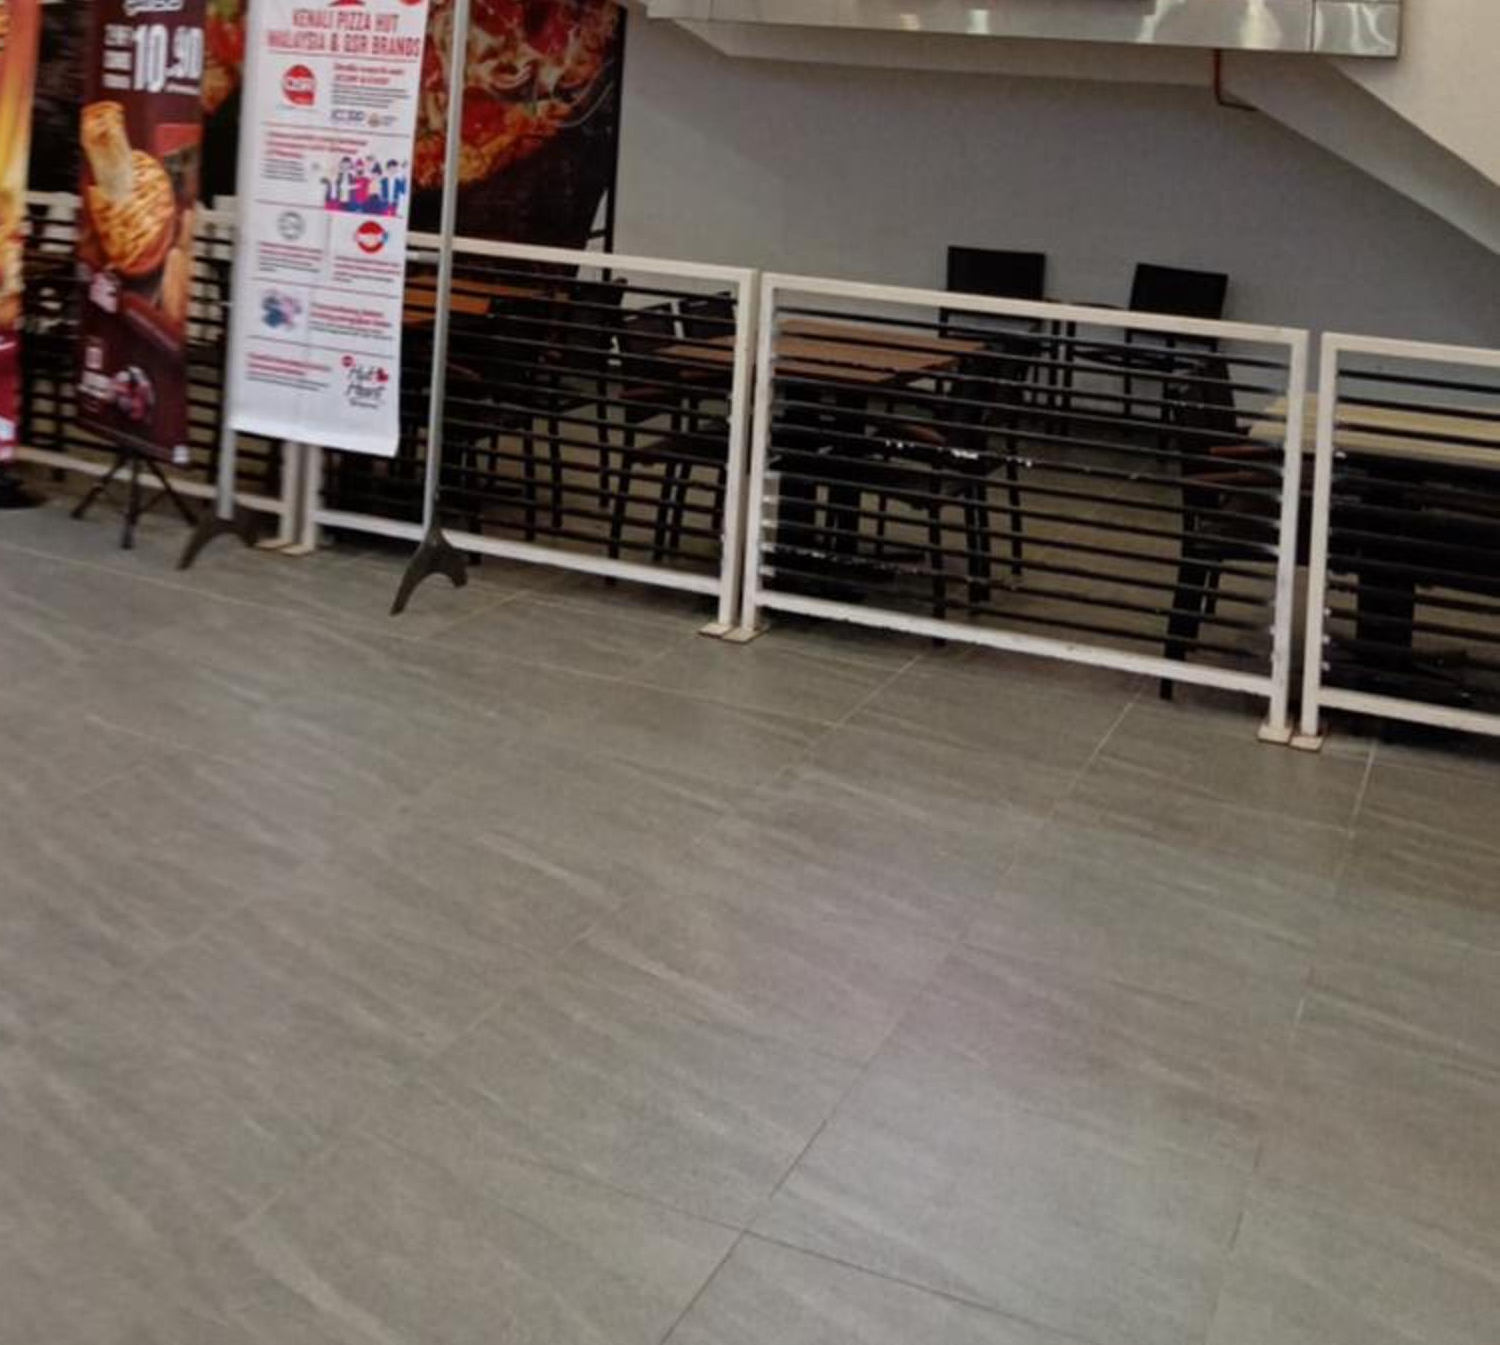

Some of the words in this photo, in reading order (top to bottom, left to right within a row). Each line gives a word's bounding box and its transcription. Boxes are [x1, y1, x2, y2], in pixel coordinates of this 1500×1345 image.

[336, 10, 372, 32] PIZZA
[374, 13, 400, 33] HUT
[266, 30, 326, 51] MALAYSIA
[371, 35, 422, 58] BRANDS
